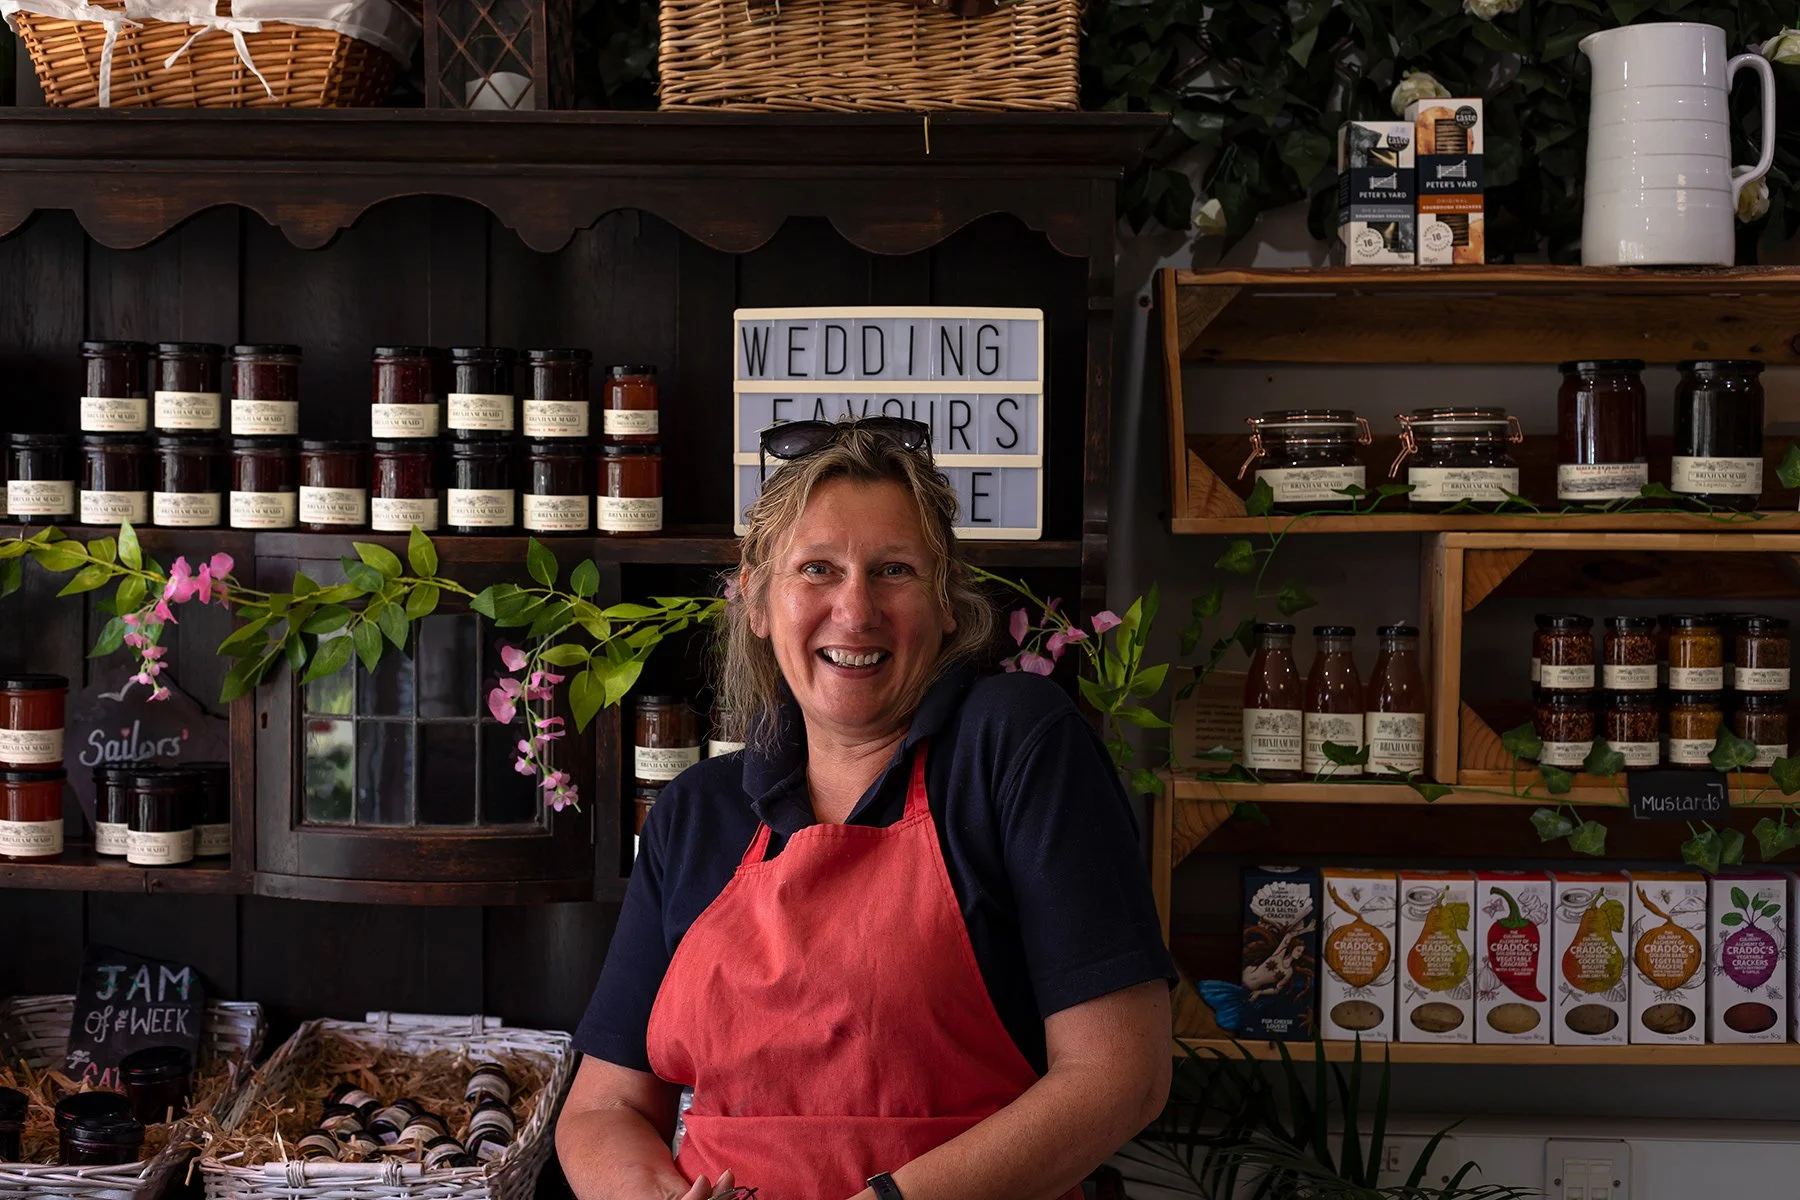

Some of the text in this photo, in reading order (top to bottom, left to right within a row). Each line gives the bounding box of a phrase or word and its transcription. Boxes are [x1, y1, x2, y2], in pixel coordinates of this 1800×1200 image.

[1425, 180, 1478, 189] PETER'S YARD
[1432, 233, 1442, 242] 16
[1364, 238, 1373, 248] 16
[741, 323, 1000, 377] WEDDING
[1258, 738, 1288, 747] BRIXHAM
[1380, 742, 1410, 752] BRIXHAM
[1642, 794, 1721, 812] Mustards
[1258, 898, 1304, 908] CRADOC'S
[1334, 940, 1384, 951] CRADOC'S
[1416, 944, 1462, 952] CRADOC'S
[1490, 943, 1538, 952] CRADOC'S
[1570, 946, 1616, 954] CRADOC'S
[1644, 944, 1694, 953] CRADOC'S
[1726, 946, 1774, 955] CRADOC'S
[96, 964, 191, 1003] JAM
[130, 1006, 190, 1036] WEEK
